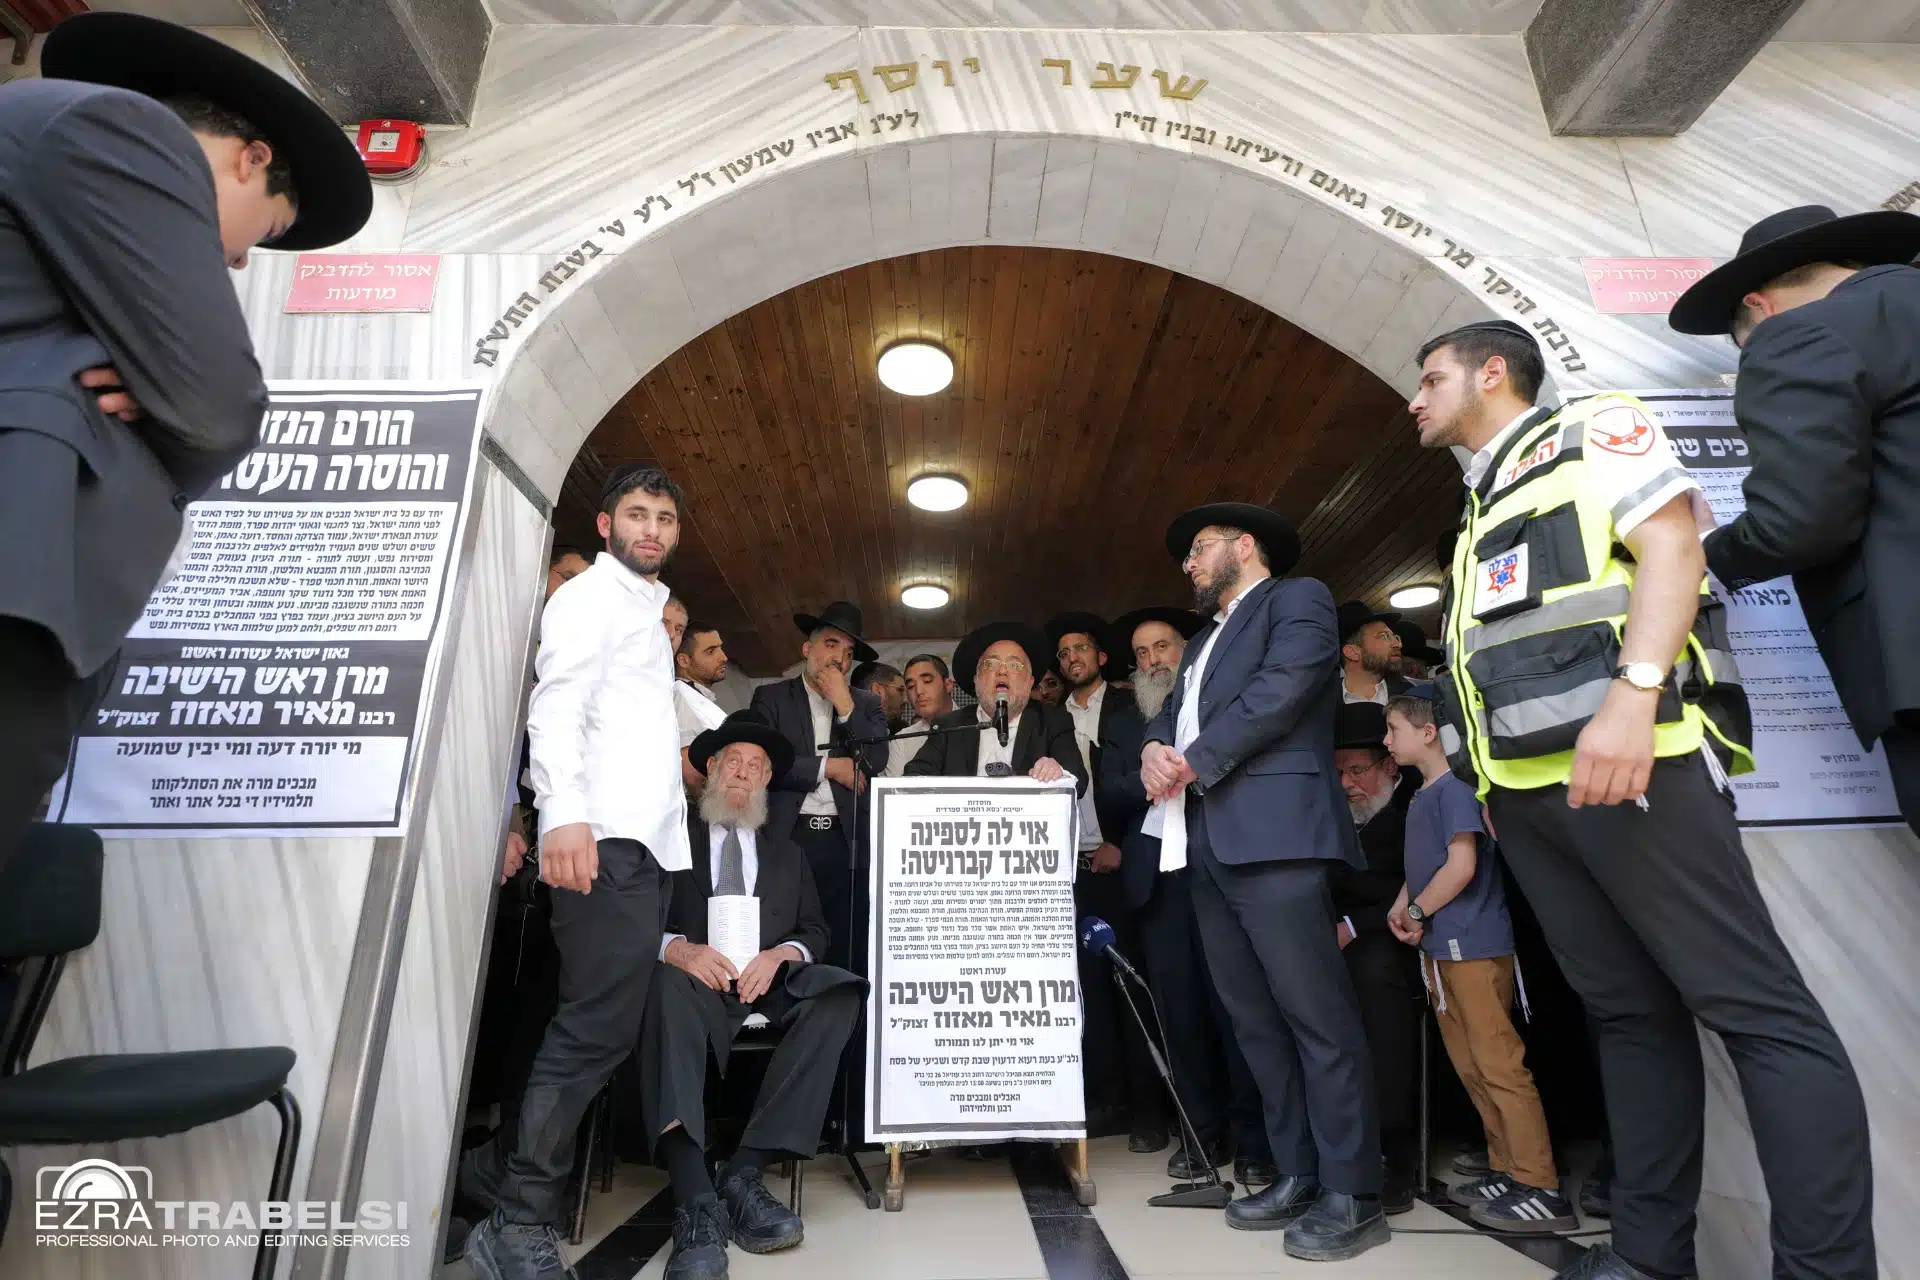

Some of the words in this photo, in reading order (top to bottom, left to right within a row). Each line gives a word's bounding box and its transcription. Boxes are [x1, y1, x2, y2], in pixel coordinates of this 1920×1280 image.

[824, 56, 981, 104] יוסף
[870, 109, 919, 134] לע"נ
[1115, 111, 1157, 133] הי"ו
[806, 121, 859, 148] אביו
[1166, 121, 1216, 146] ובניו
[719, 139, 796, 185] שמעון
[1223, 134, 1304, 178] ורעיתו
[677, 172, 716, 196] ז"ל
[1307, 169, 1368, 212] גאנם
[633, 195, 672, 224] נ"ע
[1378, 205, 1432, 240] יוסף
[1444, 238, 1475, 269] מר
[300, 261, 376, 280] להדביק
[383, 264, 432, 277] אסור
[538, 240, 605, 294] בטבת
[1589, 267, 1658, 283] להדביק
[324, 287, 397, 301] מודעות
[1480, 266, 1537, 317] היקר
[1531, 318, 1586, 375] נדבת
[330, 409, 415, 446] הורם
[324, 453, 450, 491] והוסרה
[247, 509, 261, 518] של
[296, 510, 308, 518] על
[354, 510, 381, 518] ישראל
[401, 509, 410, 517] כל
[413, 510, 426, 518] עם
[324, 521, 349, 529] לחכמי
[367, 520, 396, 529] ישראל,
[423, 520, 440, 528] לפני
[214, 532, 238, 540] נאמן,
[294, 533, 324, 541] הצדקה
[349, 532, 380, 540] ישראל,
[381, 532, 411, 540] תפארת
[413, 532, 438, 540] עטרת
[1488, 553, 1519, 573] הצלה
[149, 621, 168, 629] נפש
[170, 621, 211, 630] במסירות
[214, 623, 239, 632] הארץ
[240, 623, 274, 632] שלמות
[275, 624, 299, 634] למען
[300, 624, 323, 632] ולחם
[323, 624, 356, 633] שפלים,
[181, 646, 227, 659] ראשנו
[228, 647, 272, 661] עטרת
[275, 646, 320, 659] ישראל
[321, 647, 350, 661] גאון
[121, 666, 246, 694] הישיבה
[254, 667, 327, 694] ראש
[332, 666, 389, 701] מרן
[98, 709, 160, 728] זצוק"ל
[170, 701, 263, 725] מאזוז
[274, 701, 355, 725] מאיר
[359, 712, 395, 725] רבנו
[117, 742, 182, 757] שמועה
[187, 742, 220, 758] יבין
[226, 742, 252, 755] ומי
[257, 742, 296, 757] דעה
[300, 742, 337, 755] יורה
[343, 742, 362, 754] מי
[152, 776, 219, 792] הסתלקותו
[222, 778, 243, 790] את
[246, 778, 273, 789] מרה
[276, 778, 317, 789] מבכים
[150, 797, 181, 808] ואתר
[185, 796, 213, 808] אתר
[217, 794, 241, 808] בכל
[246, 796, 259, 807] די
[263, 794, 313, 808] תלמידין
[911, 817, 981, 845] לספינה
[988, 817, 1013, 845] לה
[1019, 821, 1049, 845] אוי
[901, 849, 993, 880] קברניטה!
[999, 850, 1059, 874] שאבד
[985, 967, 1006, 975] עטרת
[890, 981, 973, 1004] הישיבה
[980, 980, 1032, 1004] ראש
[1039, 980, 1076, 1008] מרן
[890, 1017, 928, 1030] זצוק"ל
[934, 1011, 993, 1028] מאזוז
[1000, 1010, 1051, 1027] מאיר
[1055, 1017, 1075, 1026] רבנו
[935, 1039, 970, 1047] תמורתו
[973, 1037, 986, 1046] לנו
[989, 1038, 1004, 1048] יתן
[1006, 1038, 1017, 1046] מי
[890, 1057, 906, 1065] פסח
[908, 1056, 920, 1065] של
[923, 1057, 949, 1066] ושביעי
[951, 1057, 970, 1066] קדש
[1018, 1056, 1037, 1064] רעוא
[1039, 1056, 1055, 1064] בעת
[993, 1093, 1020, 1101] האבלים
[960, 1104, 995, 1113] ותלמידהון
[997, 1105, 1011, 1113] רבנן
